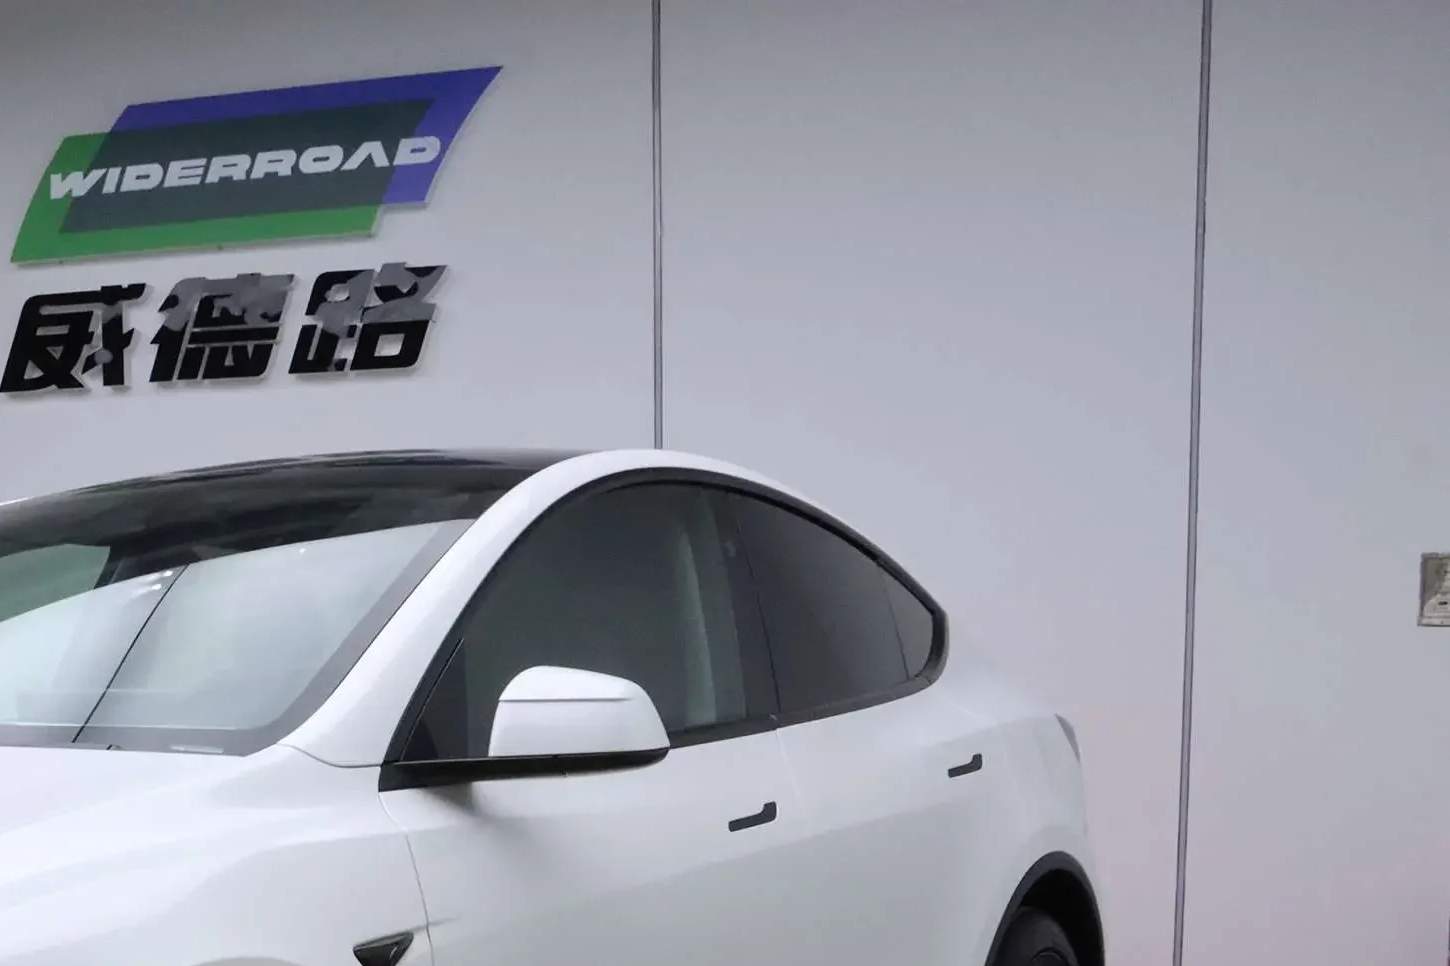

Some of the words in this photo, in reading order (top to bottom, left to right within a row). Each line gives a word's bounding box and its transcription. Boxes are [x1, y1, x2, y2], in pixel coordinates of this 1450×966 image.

[50, 135, 441, 200] WIDERROAD
[0, 262, 446, 392] 威德路
